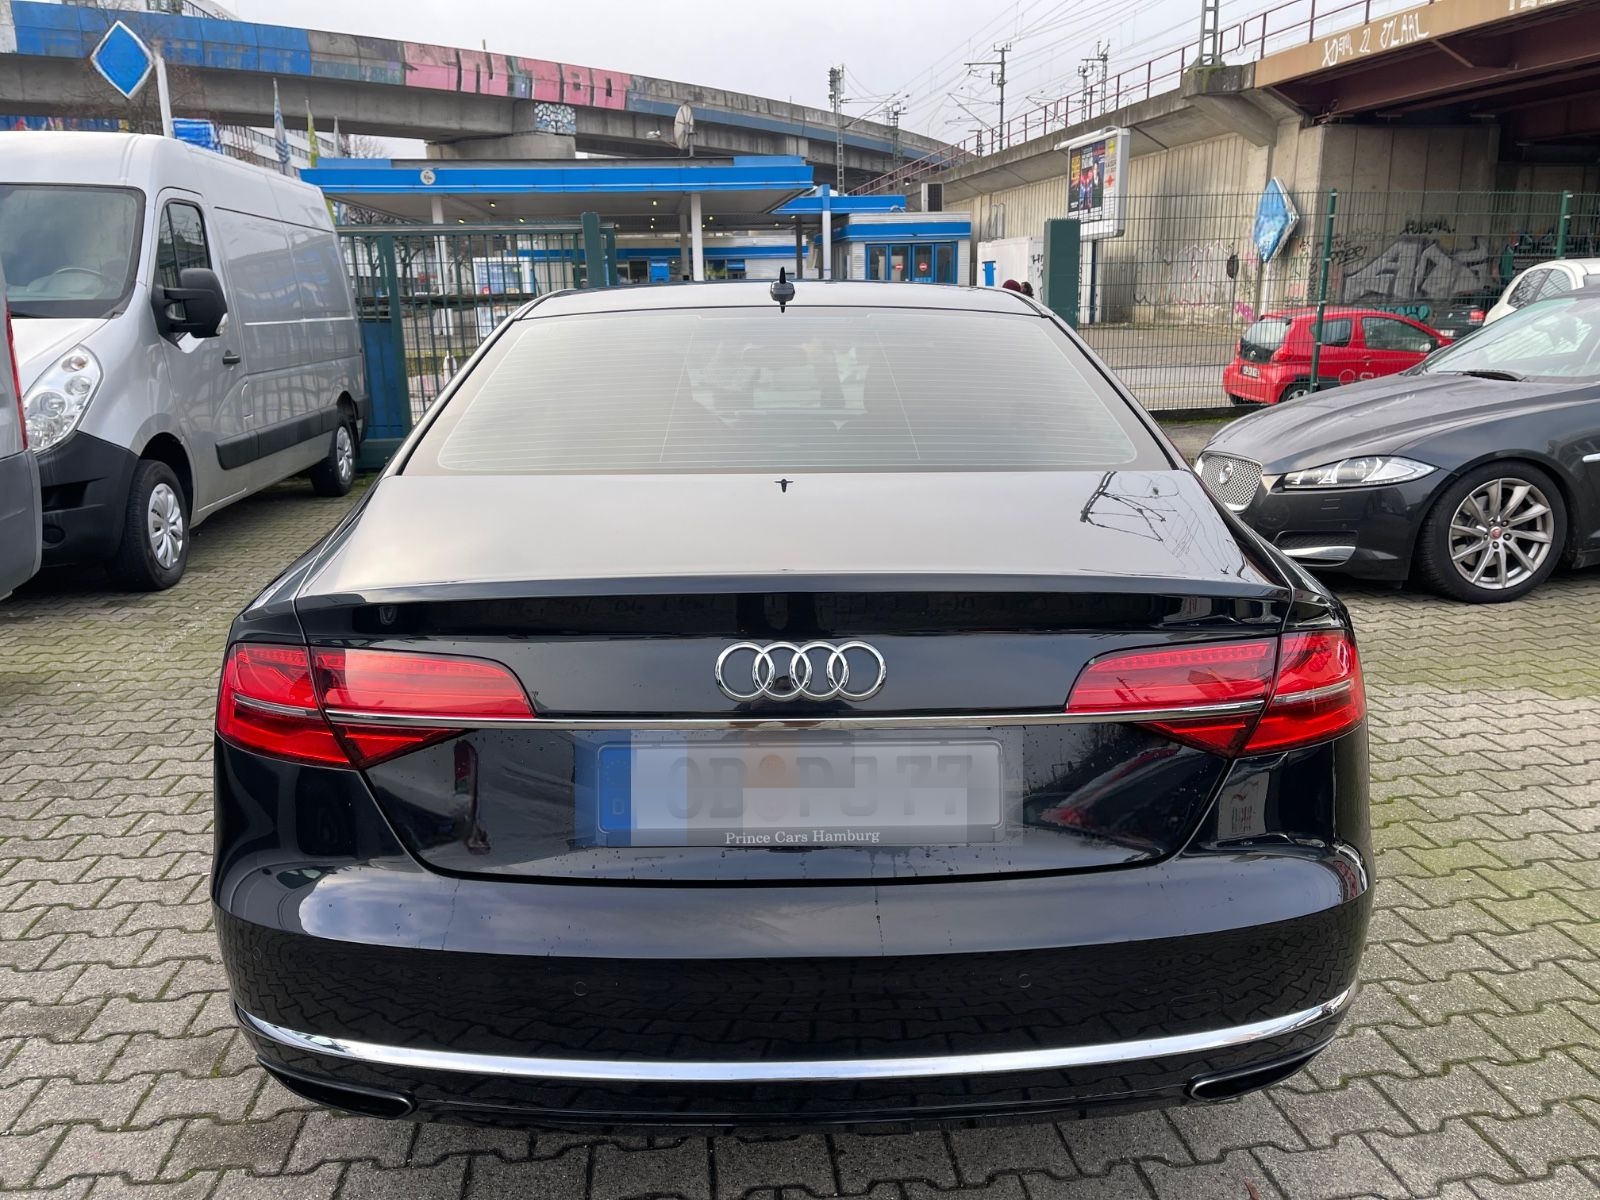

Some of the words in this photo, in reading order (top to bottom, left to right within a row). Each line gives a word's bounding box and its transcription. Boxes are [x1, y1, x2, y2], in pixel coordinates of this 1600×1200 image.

[667, 756, 747, 819] OB
[896, 755, 973, 816] 77
[725, 832, 771, 844] Prince
[775, 831, 808, 844] Cars
[812, 829, 881, 844] Hamburg
